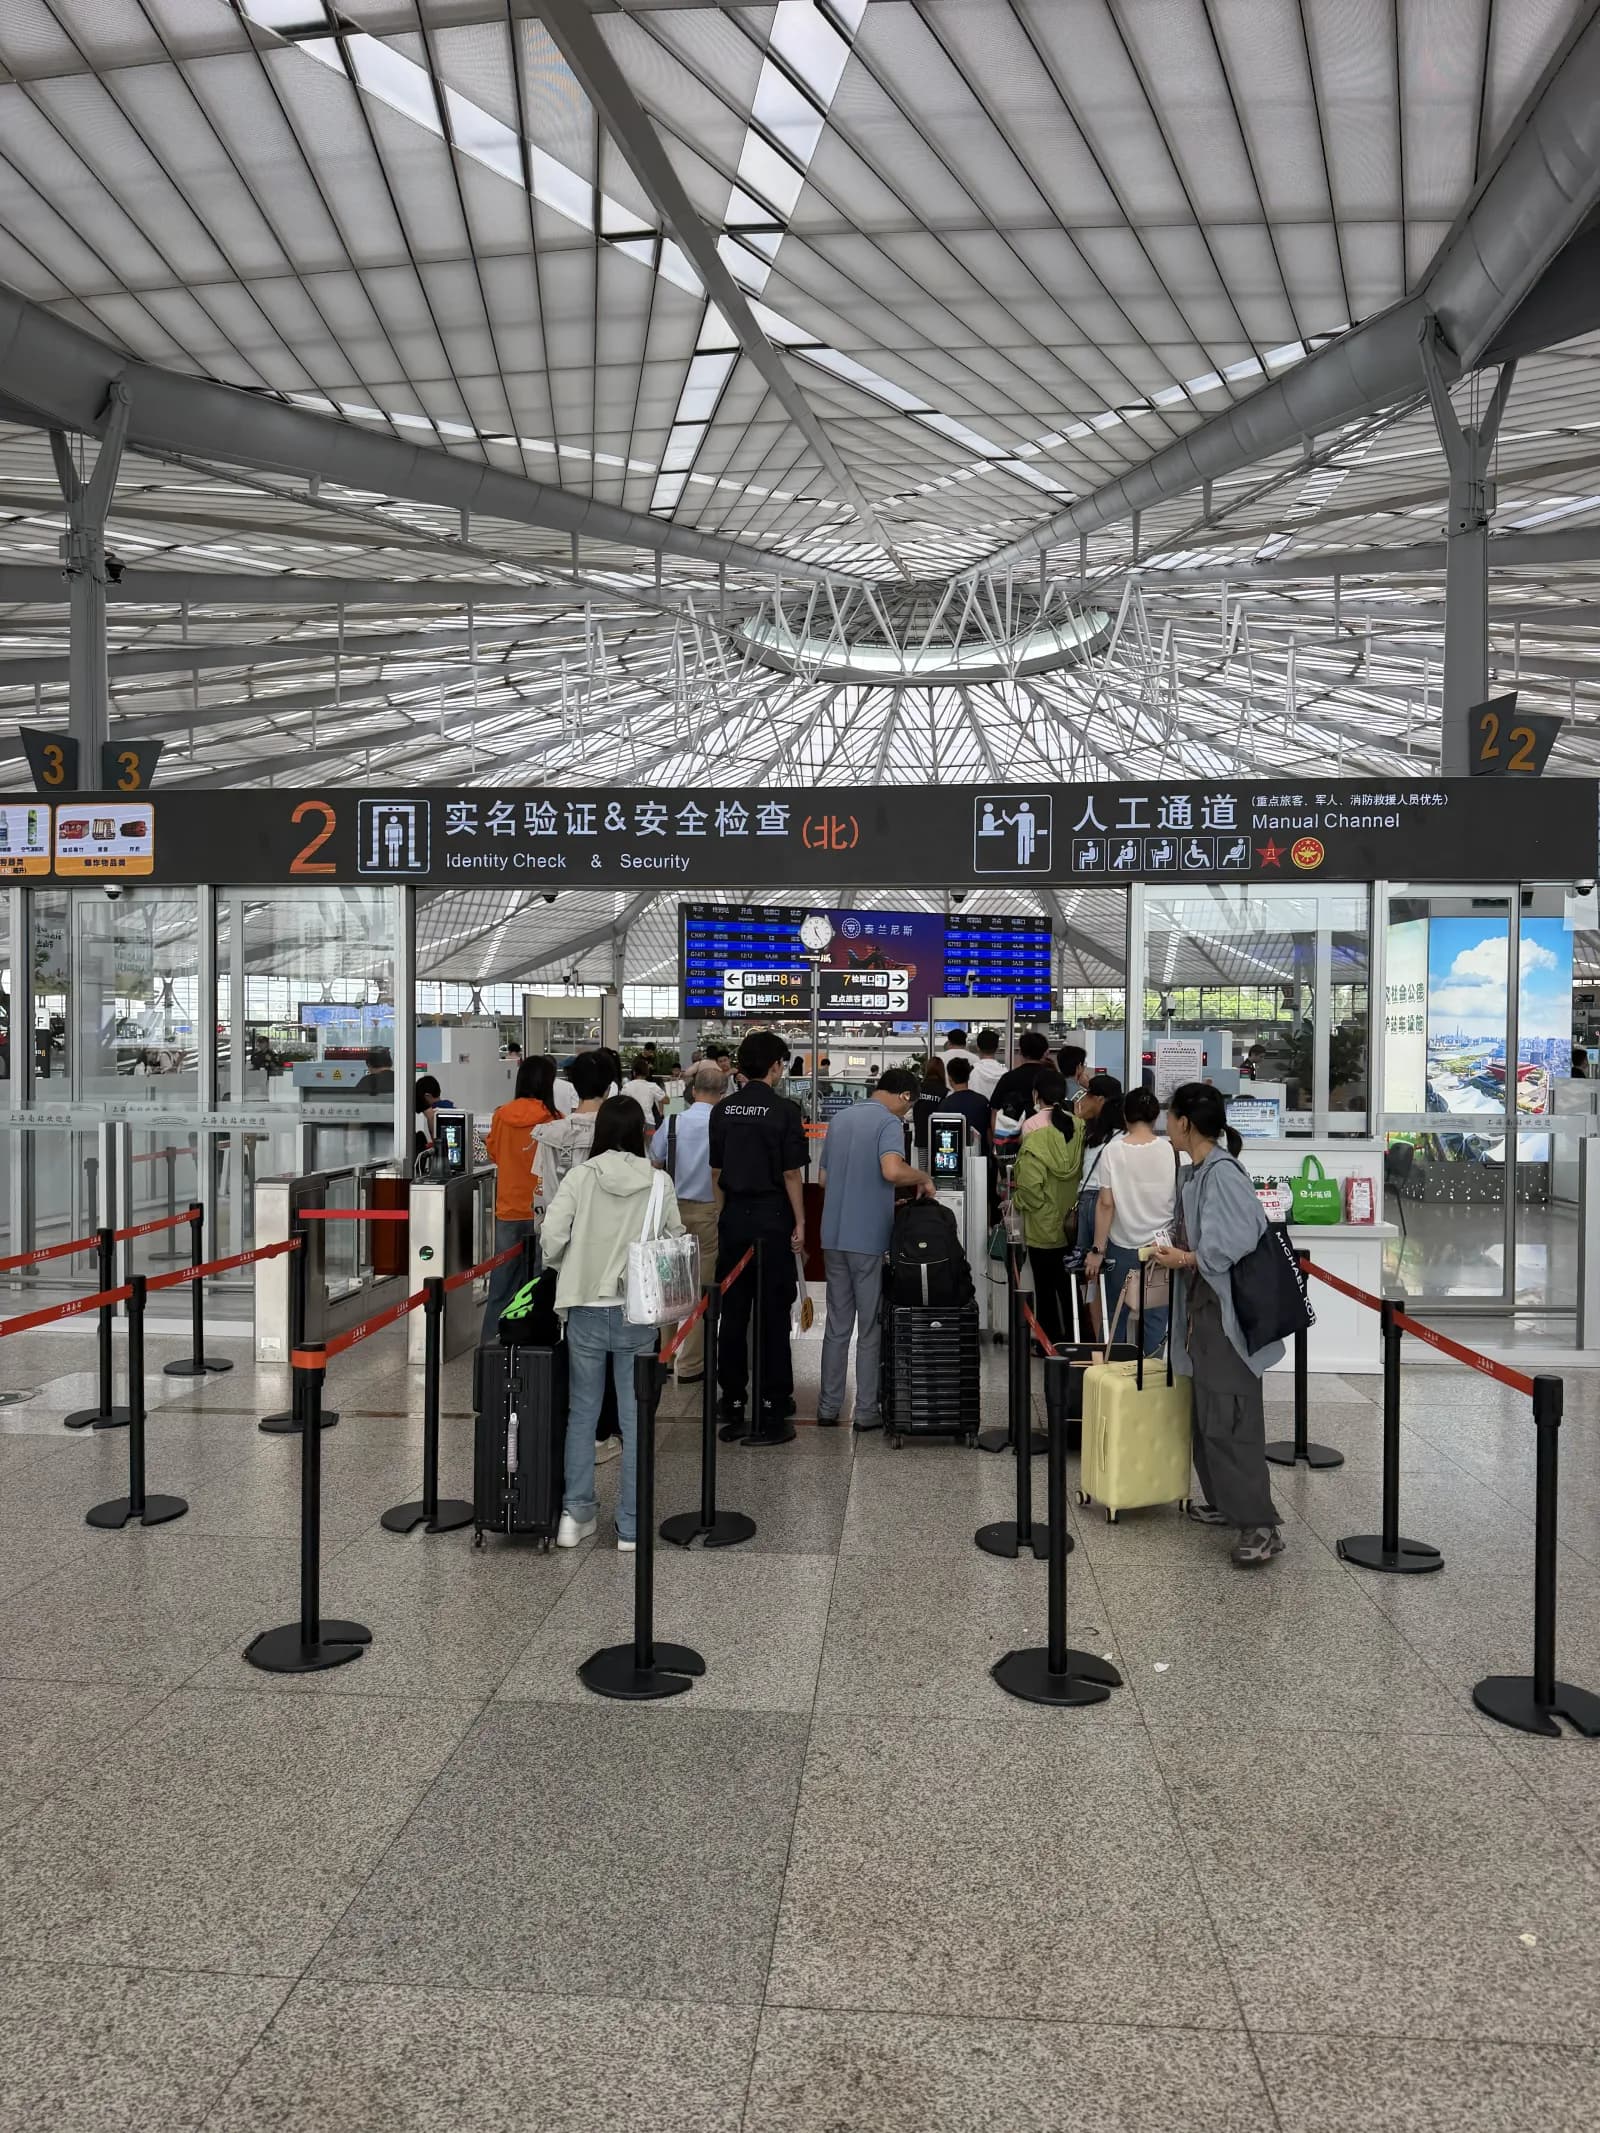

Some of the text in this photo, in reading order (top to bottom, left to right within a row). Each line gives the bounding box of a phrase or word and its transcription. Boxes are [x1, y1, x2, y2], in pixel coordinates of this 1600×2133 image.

[1480, 712, 1499, 760] 2
[1507, 727, 1536, 770] 2
[42, 745, 64, 785] 3
[117, 752, 141, 791] 3
[445, 800, 791, 838] 实名验证&安全检查
[1072, 794, 1239, 832] 人工通道
[1252, 812, 1400, 830] Manual Channel
[289, 801, 336, 874] 2
[446, 852, 690, 872] Identity Check & Security
[725, 1105, 769, 1116] SECURITY
[1276, 1231, 1317, 1326] MICHAEL KOR
